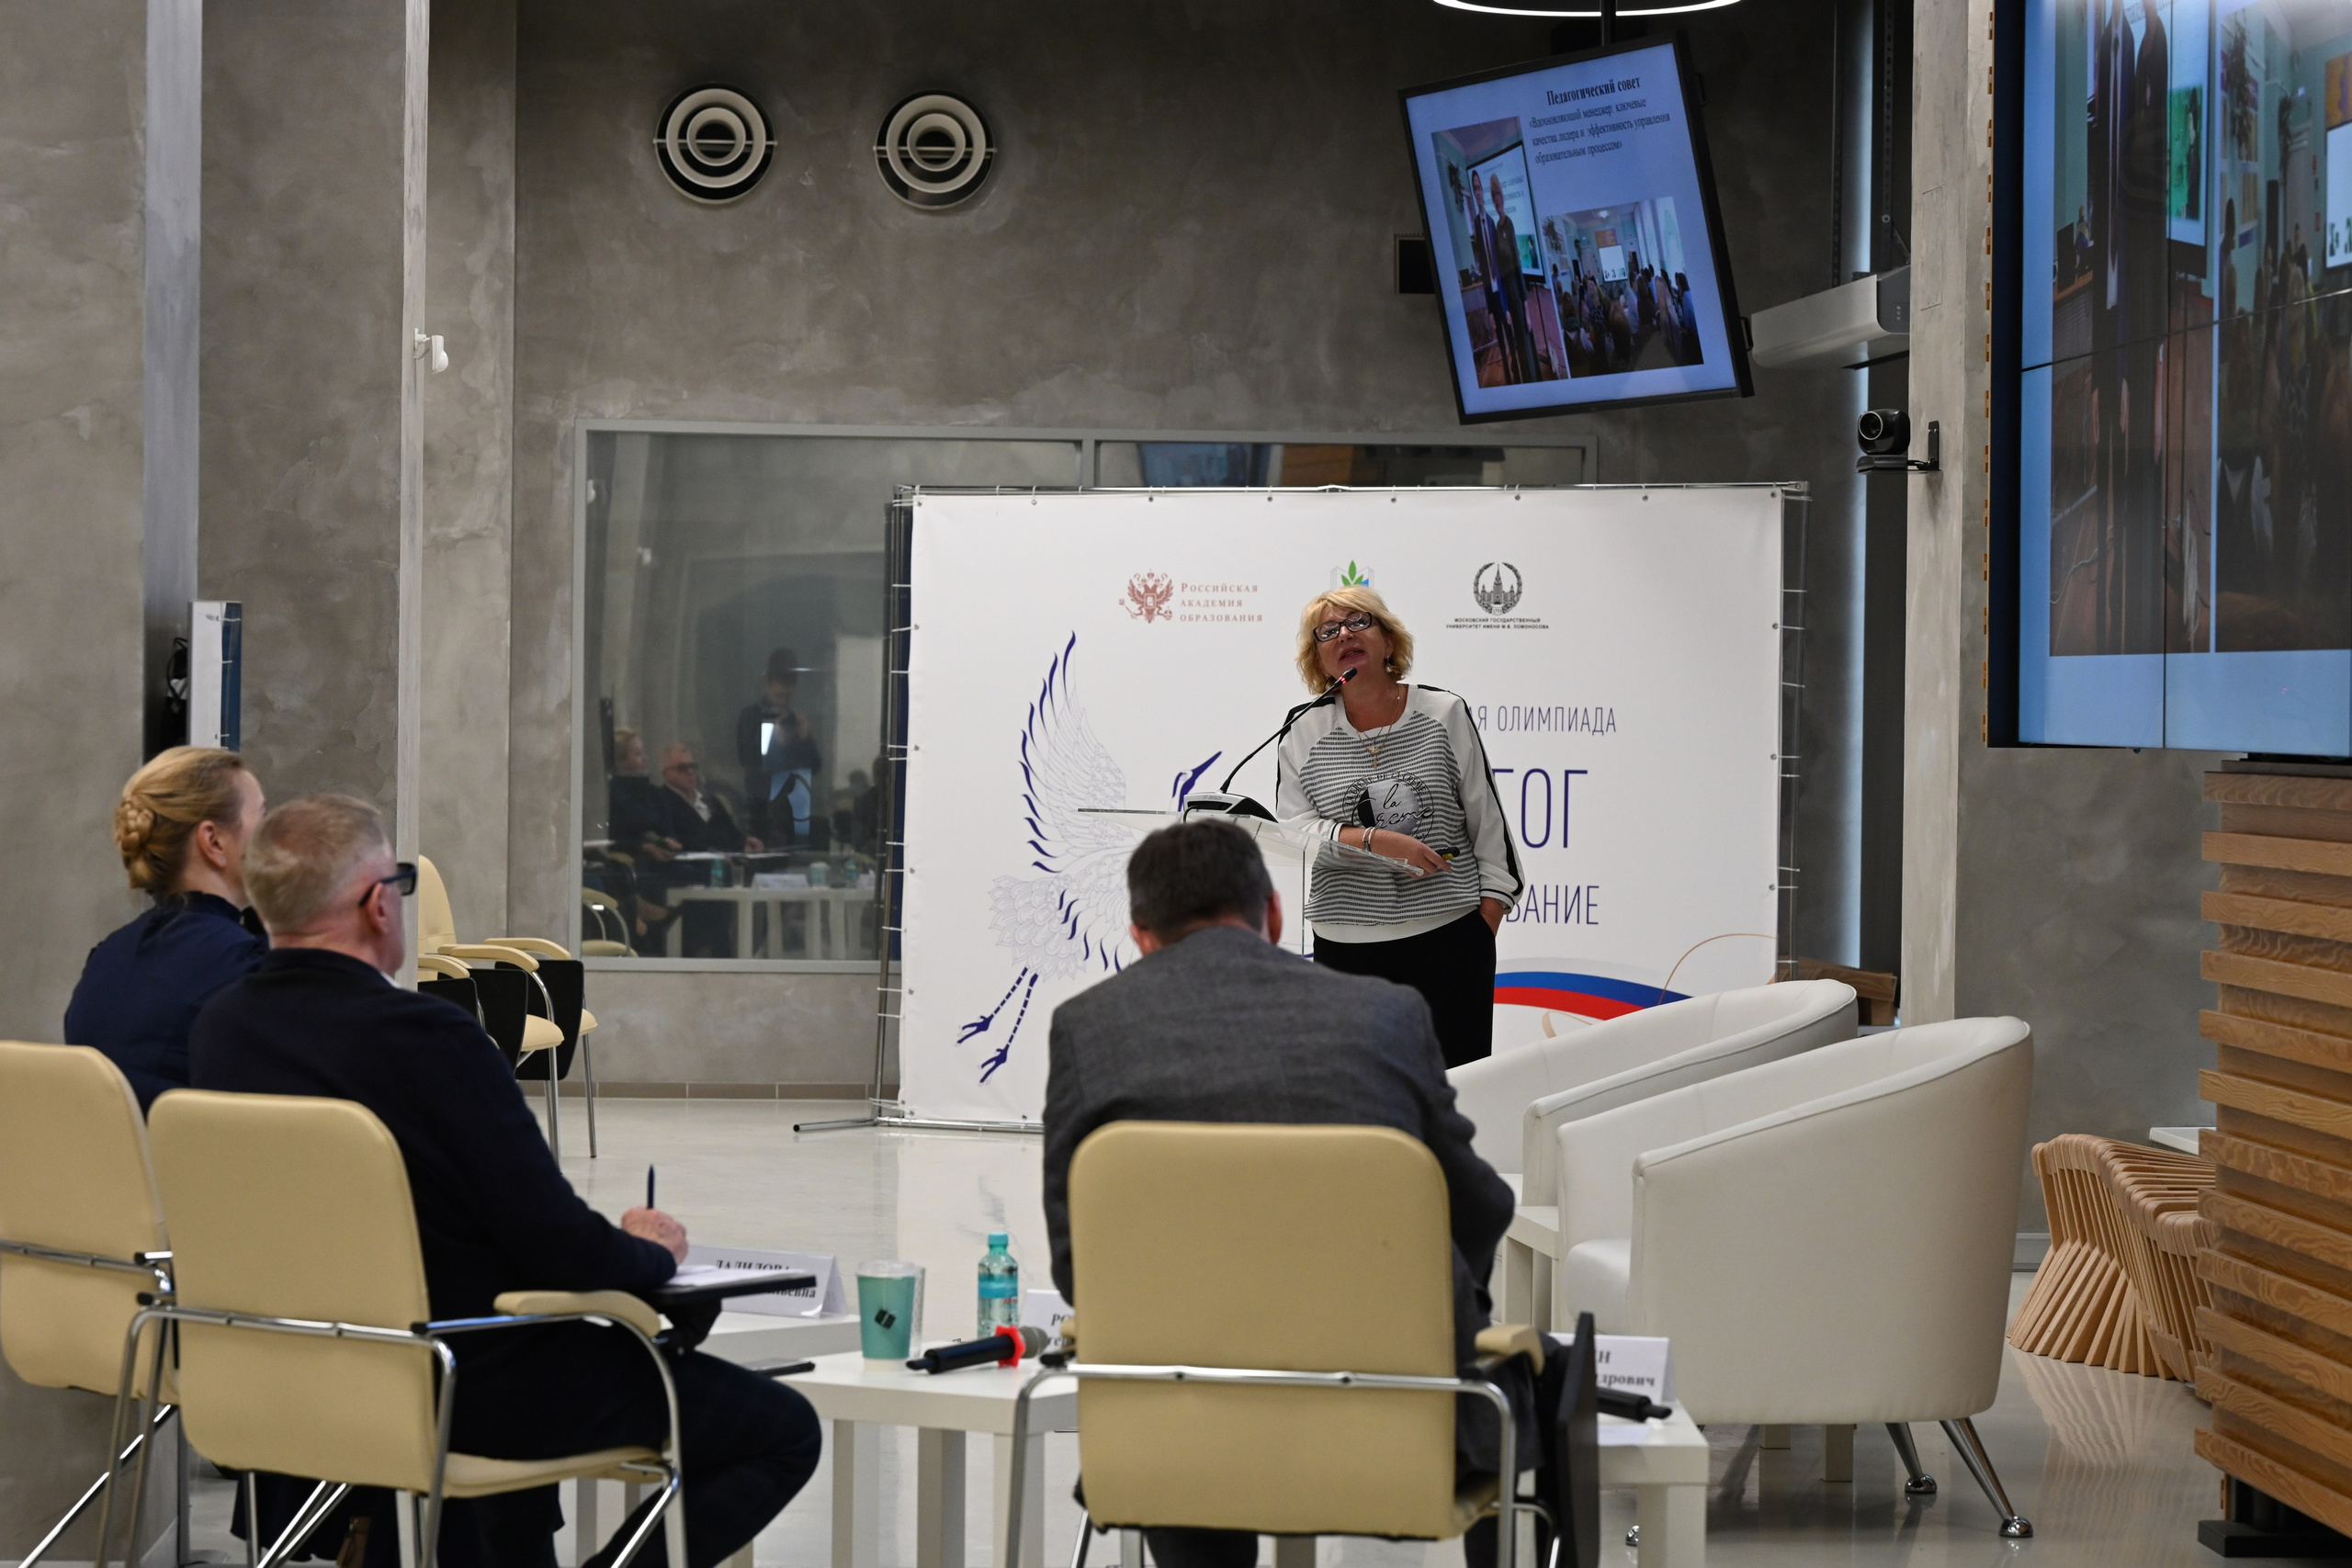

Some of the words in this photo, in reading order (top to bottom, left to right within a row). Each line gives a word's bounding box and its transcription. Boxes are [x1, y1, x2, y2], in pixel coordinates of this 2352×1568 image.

[1546, 79, 1615, 106] Педагогический
[1618, 77, 1640, 92] совет
[1615, 98, 1646, 113] ключевые
[1532, 134, 1557, 147] качества
[1558, 130, 1579, 143] лидера
[1588, 121, 1634, 138] эффективность
[1634, 112, 1670, 130] управления
[1535, 147, 1586, 165] образовательным
[1180, 600, 1242, 608] АКАДЕМИЯ
[1180, 614, 1262, 622] ОБРАЗОВАНИЯ
[1468, 705, 1487, 731] Я
[1498, 705, 1616, 737] ОЛИМПИАДА
